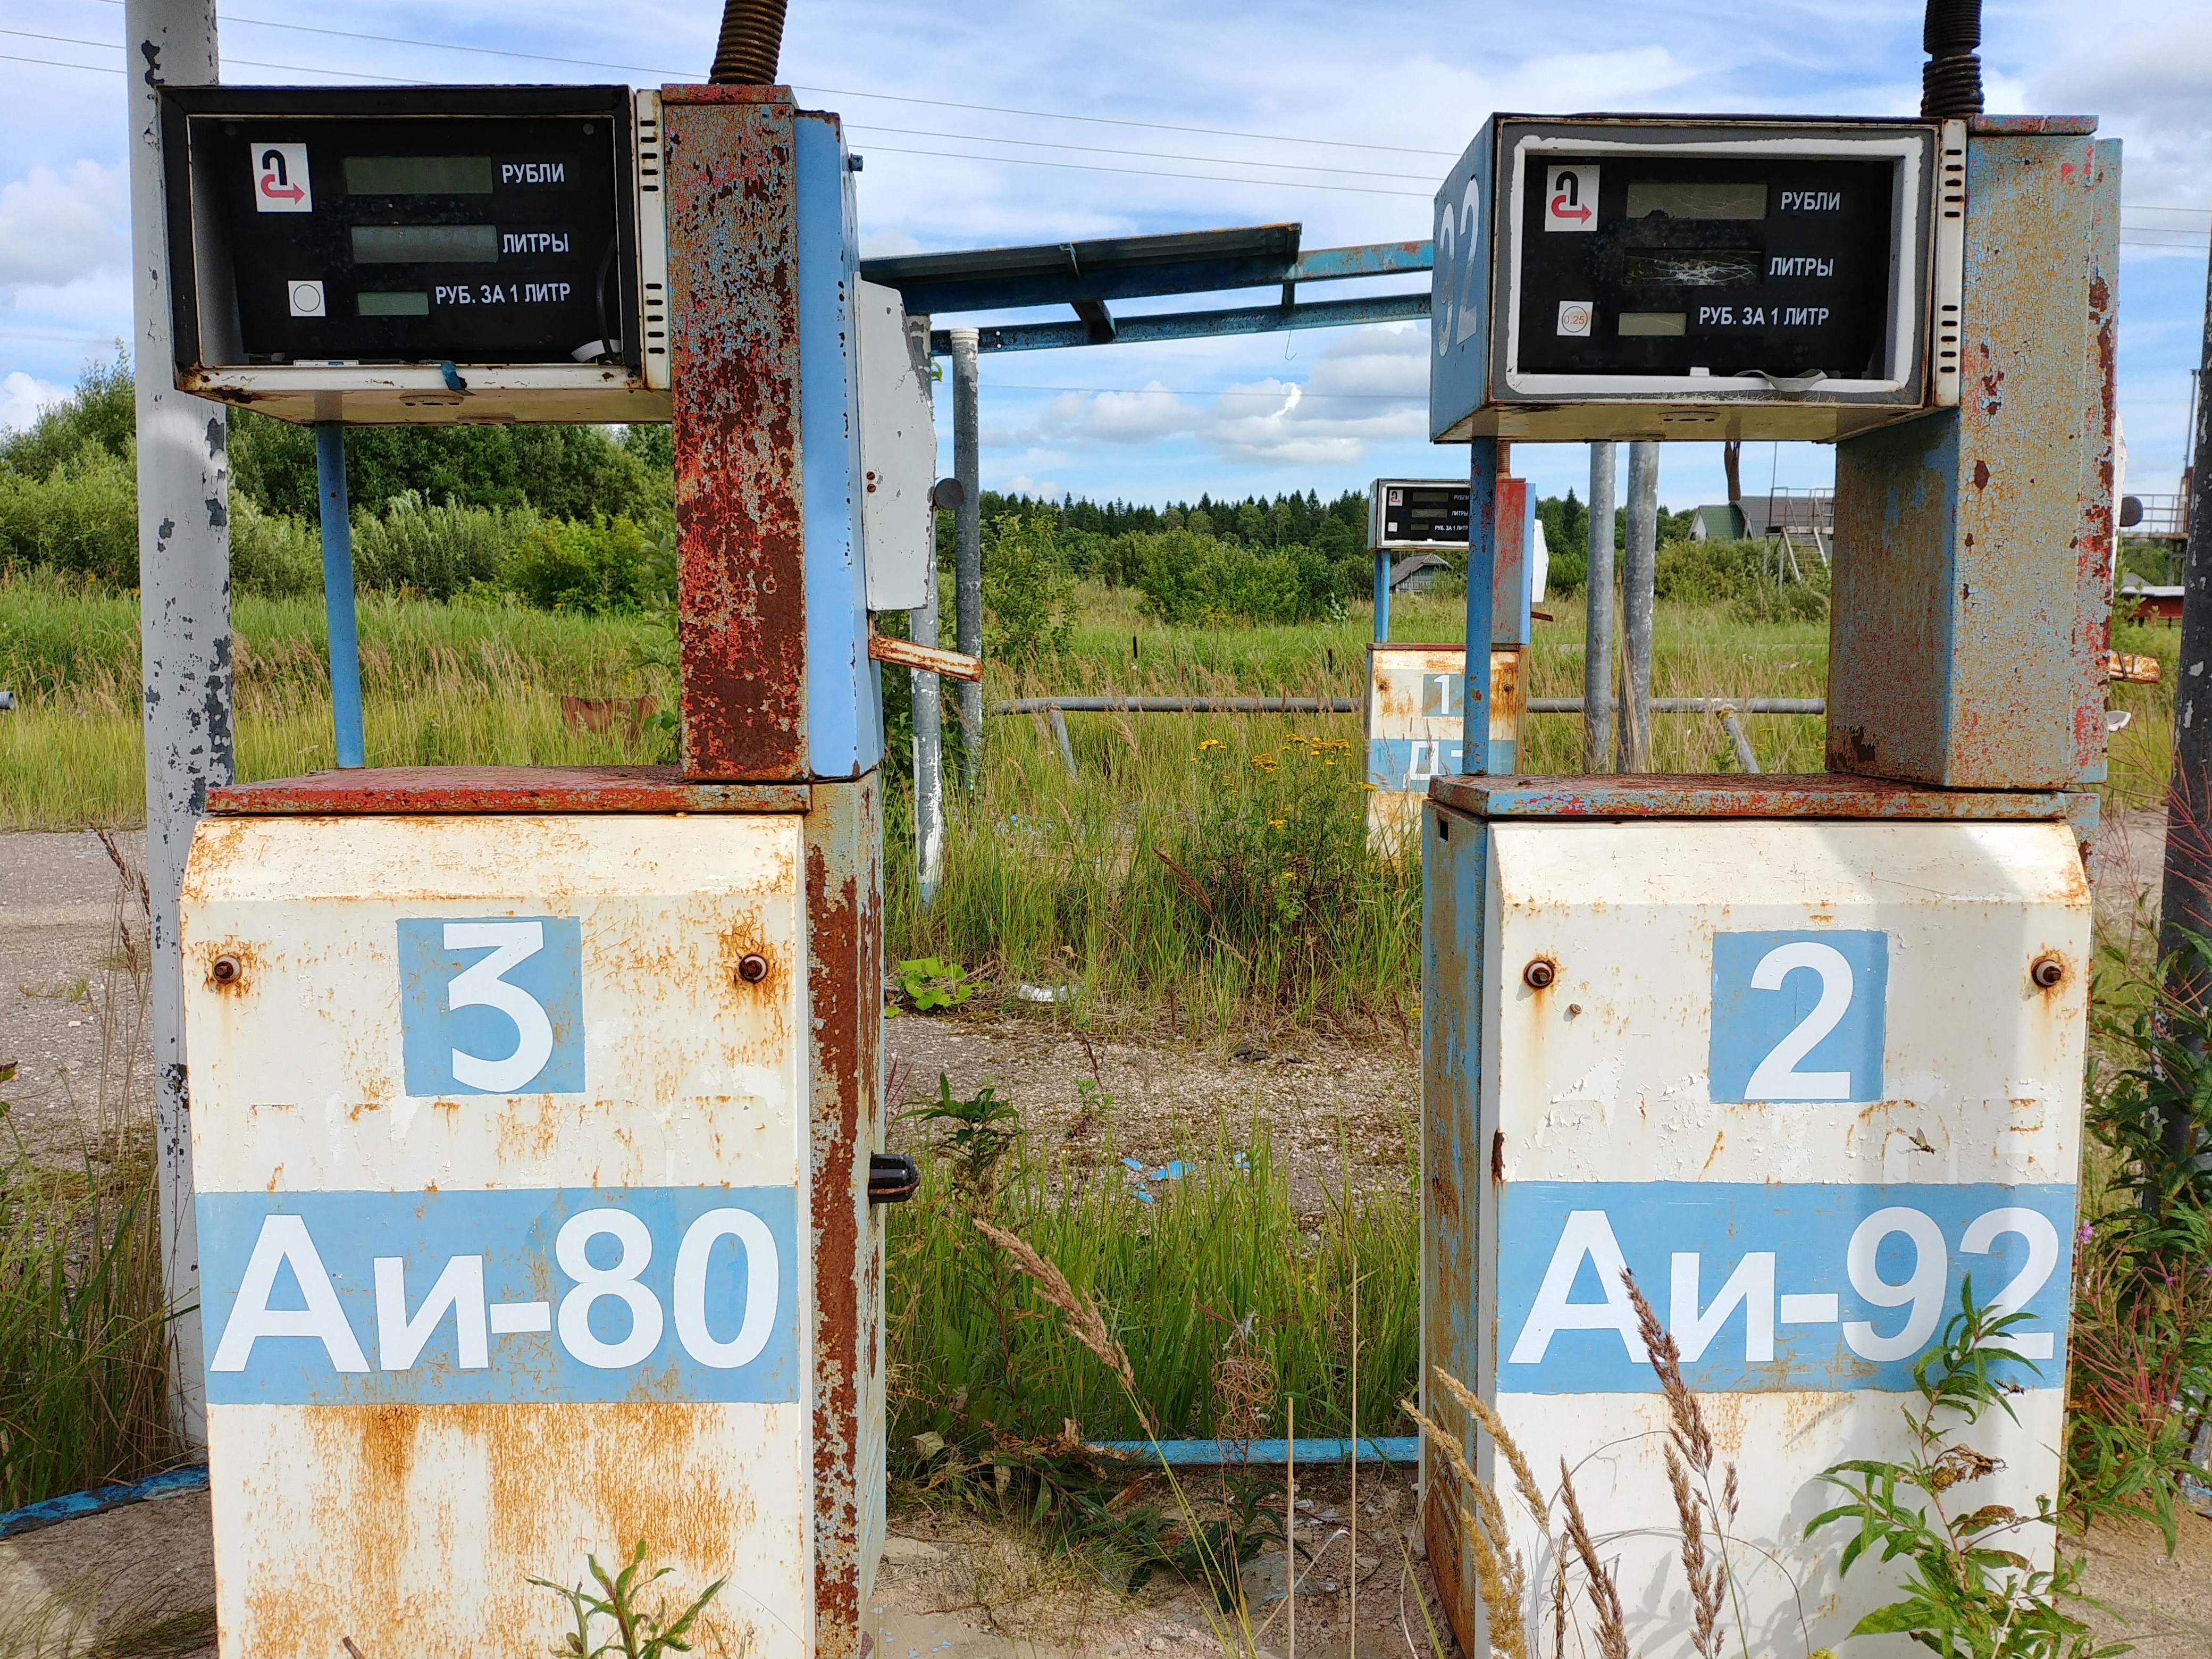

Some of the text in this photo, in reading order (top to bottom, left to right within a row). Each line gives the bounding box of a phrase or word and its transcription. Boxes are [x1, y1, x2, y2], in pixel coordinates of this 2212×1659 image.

[501, 163, 565, 184] РУБЛИ
[1780, 191, 1840, 211] РУБЛИ
[502, 233, 569, 254] ЛИТРЫ
[1438, 177, 1480, 358] 92
[1769, 256, 1834, 277] ЛИТРЫ
[435, 282, 571, 305] РУБ. ЗА 1 ЛИТР
[1564, 315, 1585, 325] 0,25
[1699, 306, 1830, 326] РУБ. ЗА 1 ЛИТР
[1434, 674, 1449, 715] 1
[443, 920, 555, 1093] 3
[1744, 941, 1854, 1100] 2
[210, 1207, 780, 1373] Аи-80
[1508, 1205, 2059, 1363] Аи-92
